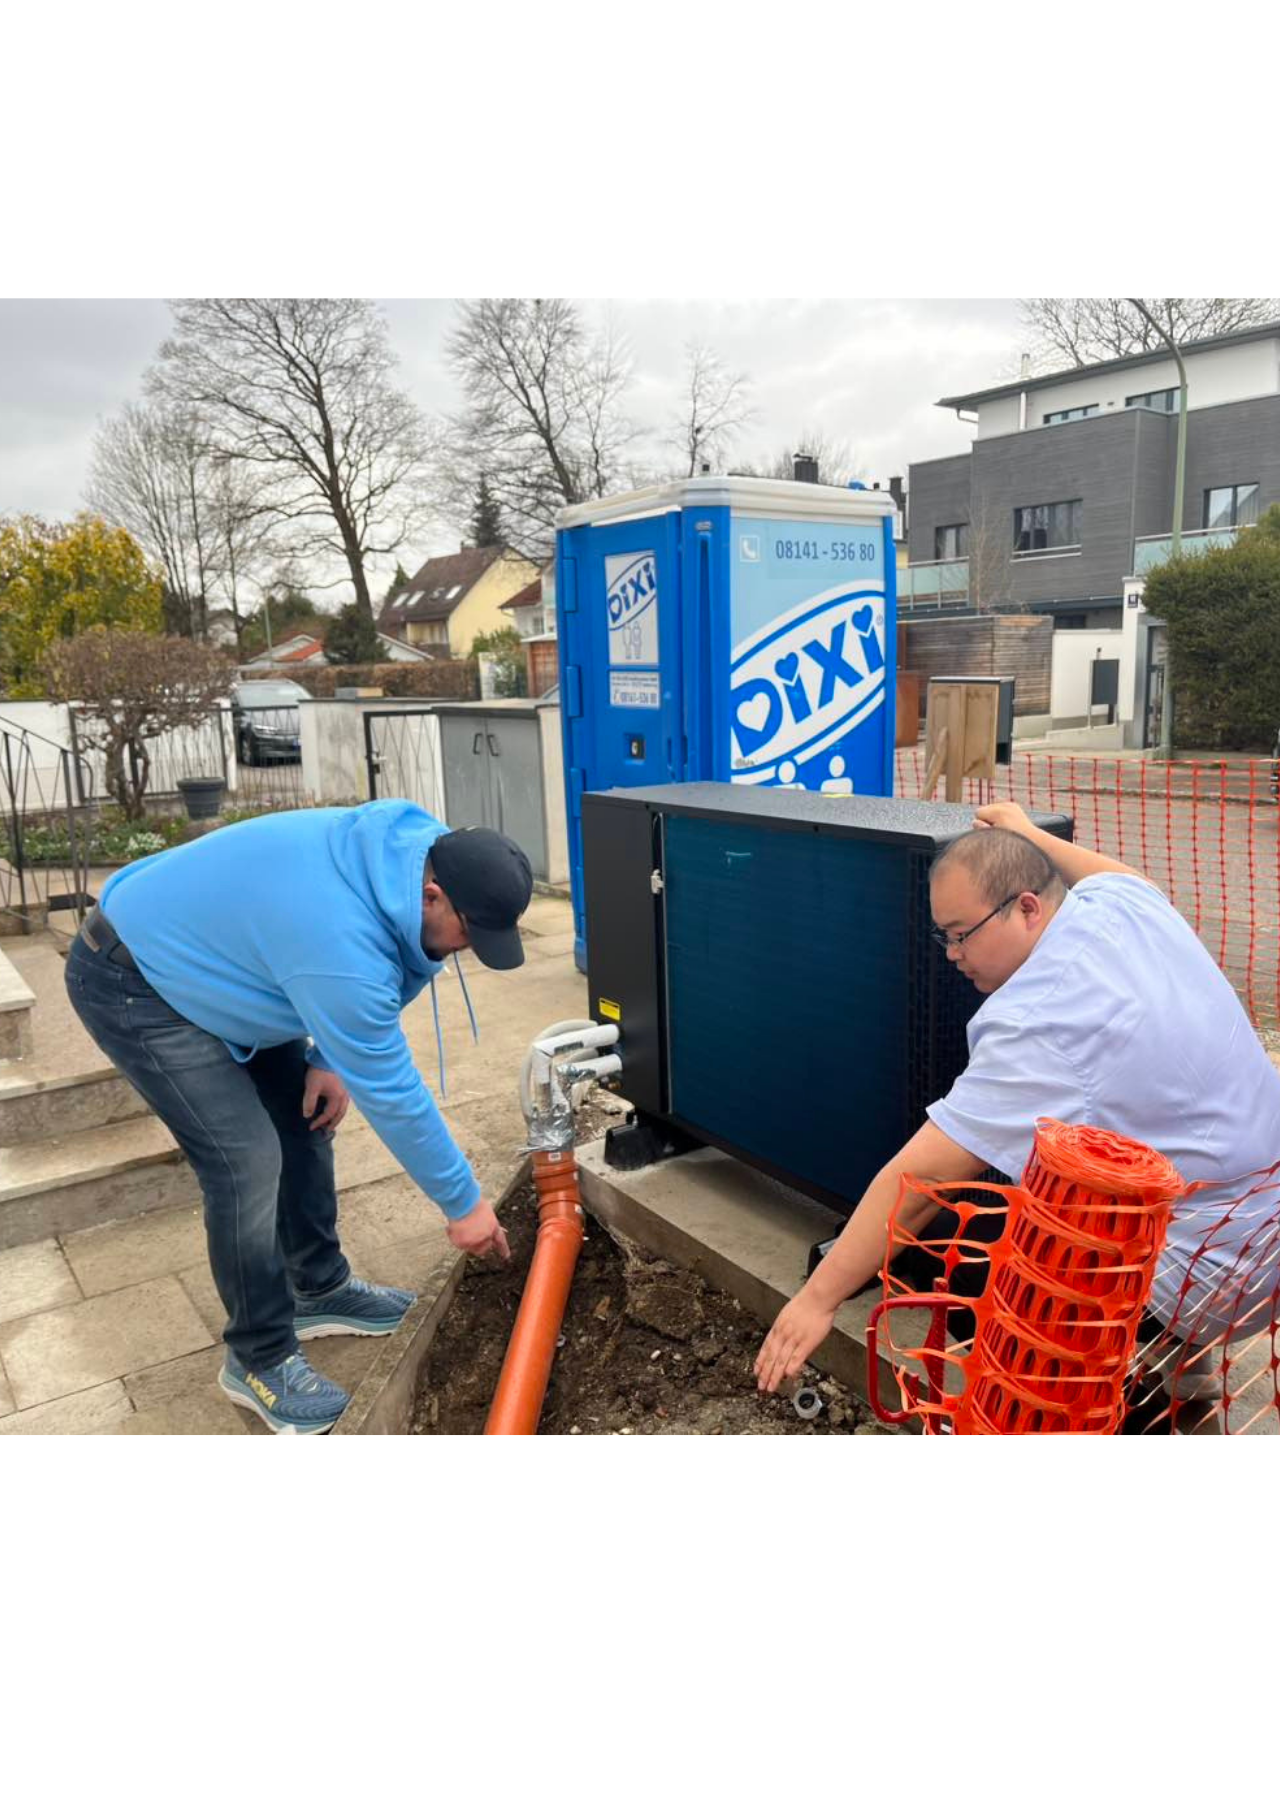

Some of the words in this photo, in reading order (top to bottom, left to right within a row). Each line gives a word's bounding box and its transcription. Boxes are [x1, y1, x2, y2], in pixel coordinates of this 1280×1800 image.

[775, 540, 819, 559] 08141
[831, 542, 855, 560] 536
[859, 543, 875, 560] 80
